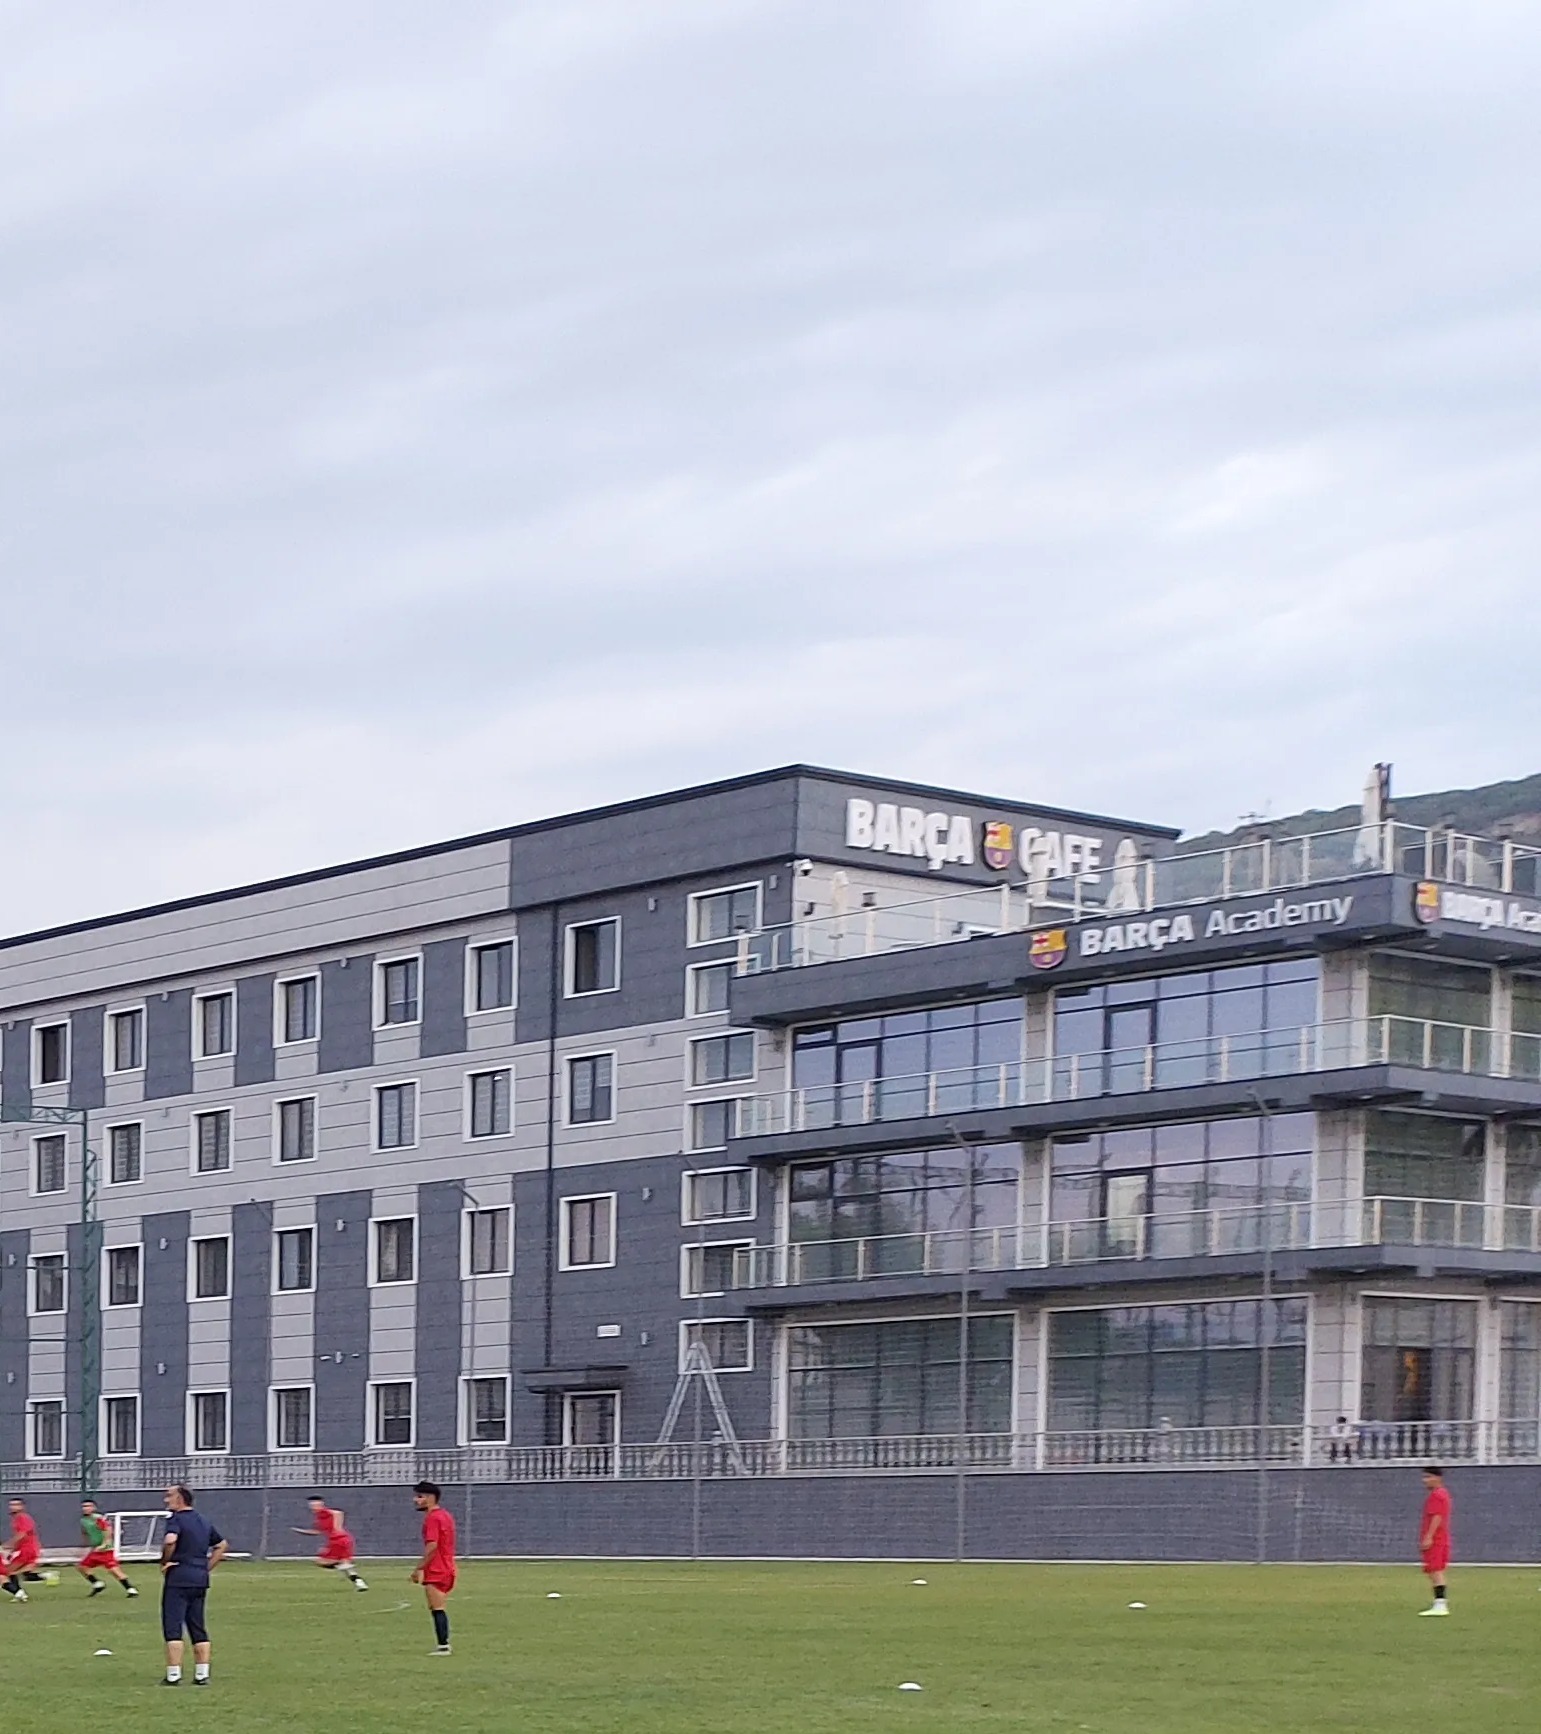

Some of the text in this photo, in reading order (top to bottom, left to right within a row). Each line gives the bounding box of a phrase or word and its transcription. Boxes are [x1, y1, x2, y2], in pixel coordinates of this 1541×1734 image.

[846, 799, 974, 870] BARÇA
[1079, 895, 1354, 955] BARÇA Academy
